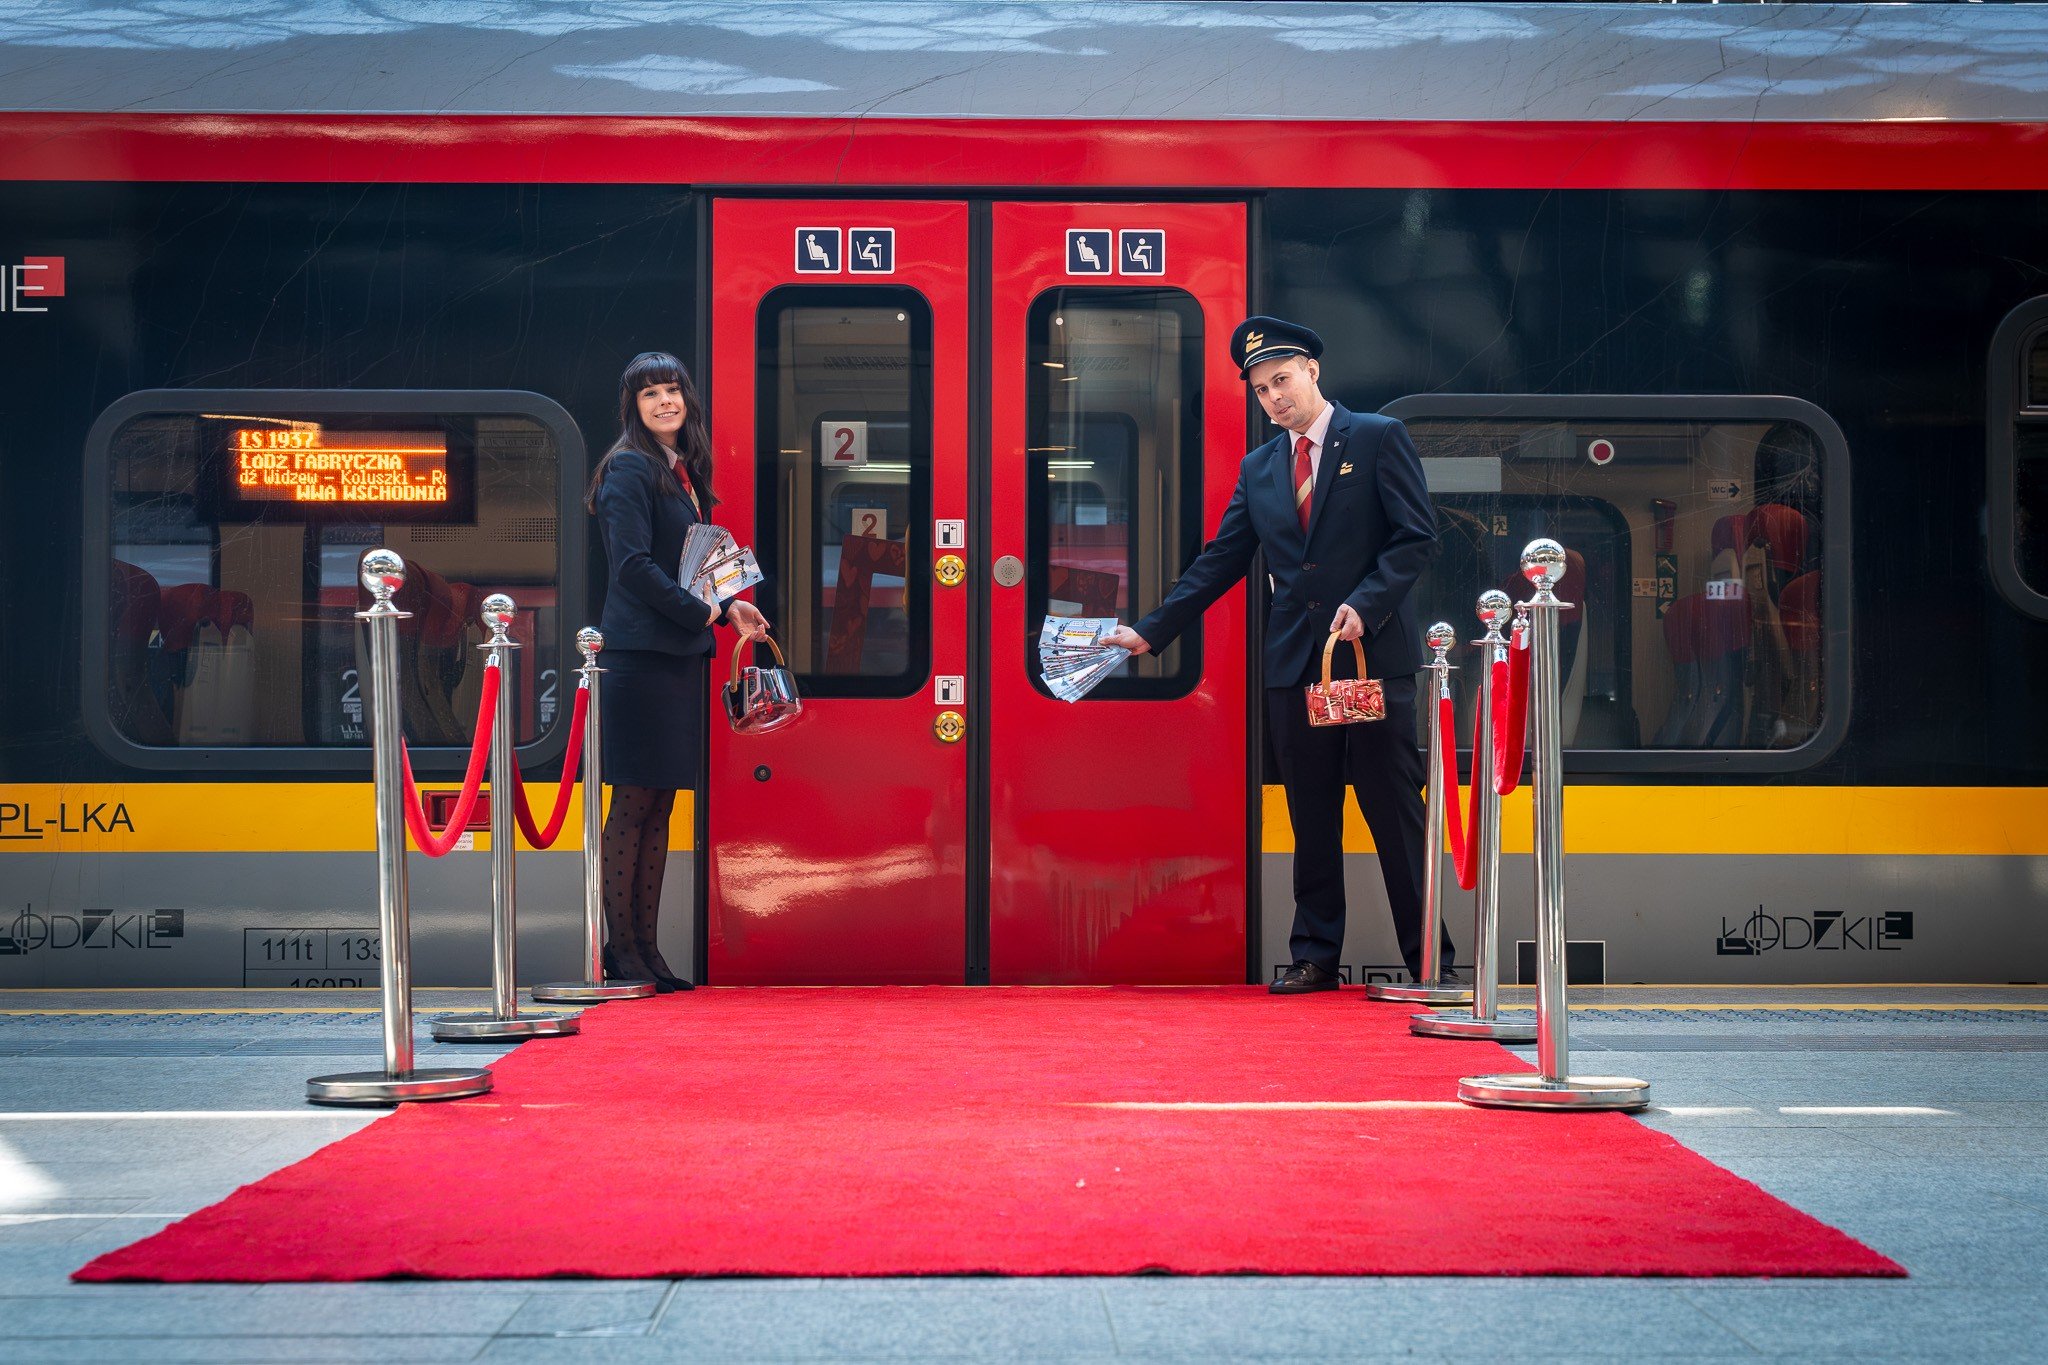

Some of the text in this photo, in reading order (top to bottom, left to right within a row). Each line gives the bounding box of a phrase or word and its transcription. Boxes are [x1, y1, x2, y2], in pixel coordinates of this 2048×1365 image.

[240, 432, 314, 448] ŁS 1937
[834, 427, 855, 460] 2
[295, 454, 402, 469] FABRYCZNA
[263, 469, 318, 485] Widzew
[341, 469, 408, 485] Koluszki
[296, 485, 447, 501] WWA WSCHODNIA
[1711, 485, 1726, 494] WC
[861, 513, 878, 539] 2
[342, 669, 362, 703] 2
[540, 669, 556, 703] 2
[0, 803, 136, 833] PL-LKA
[262, 938, 313, 960] 111t
